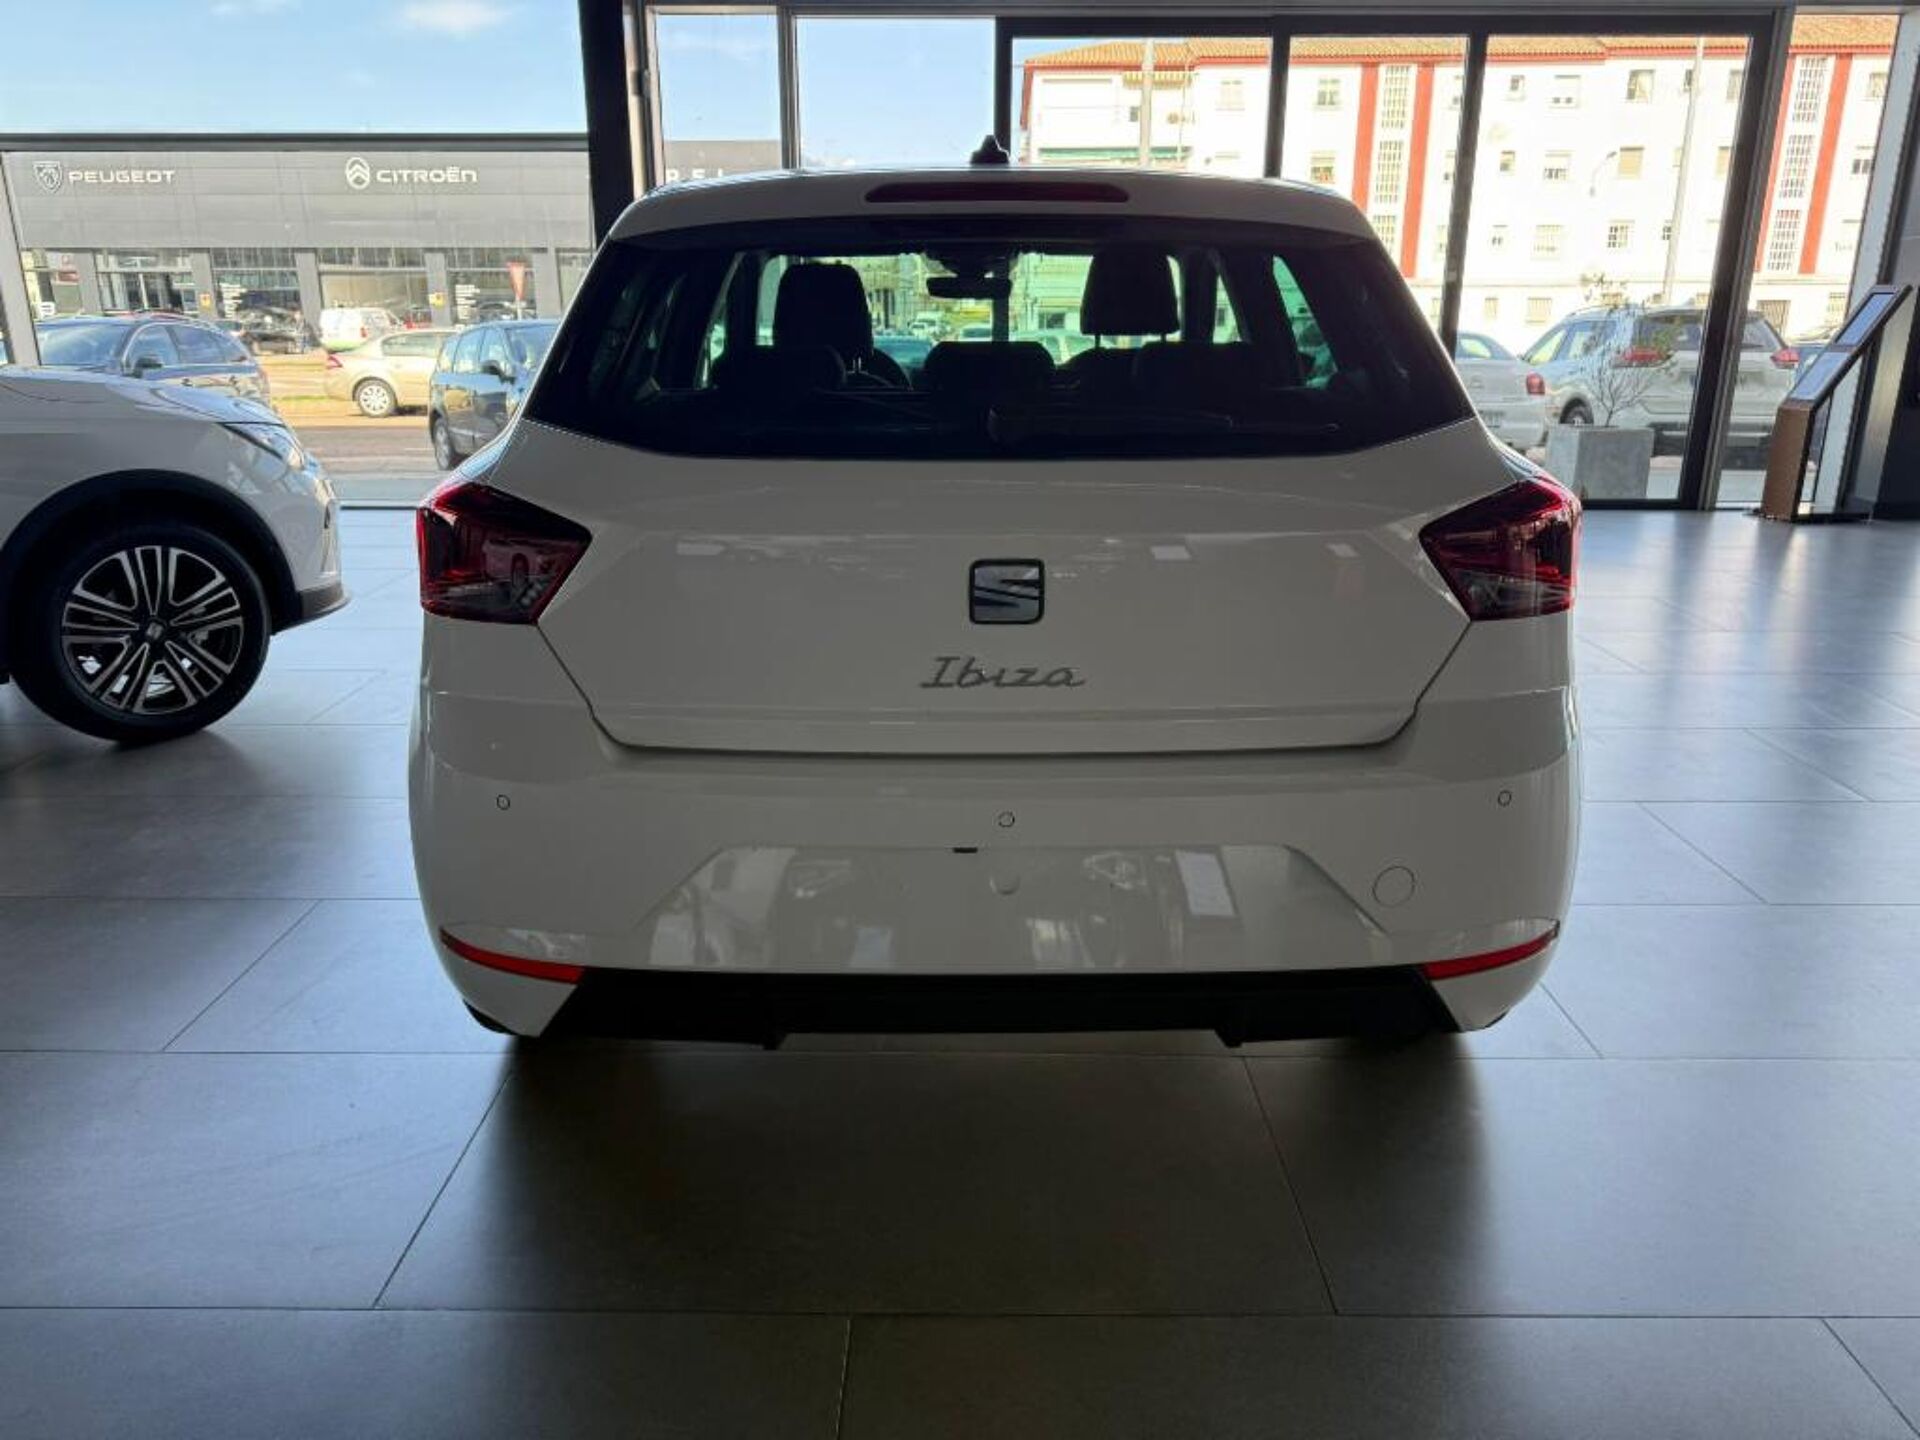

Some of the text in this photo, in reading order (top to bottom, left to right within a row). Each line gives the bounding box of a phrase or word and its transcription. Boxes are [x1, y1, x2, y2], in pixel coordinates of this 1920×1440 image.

[68, 169, 176, 184] PEUGEOT
[376, 165, 478, 184] CITROËN
[919, 656, 1087, 688] Ibiza
